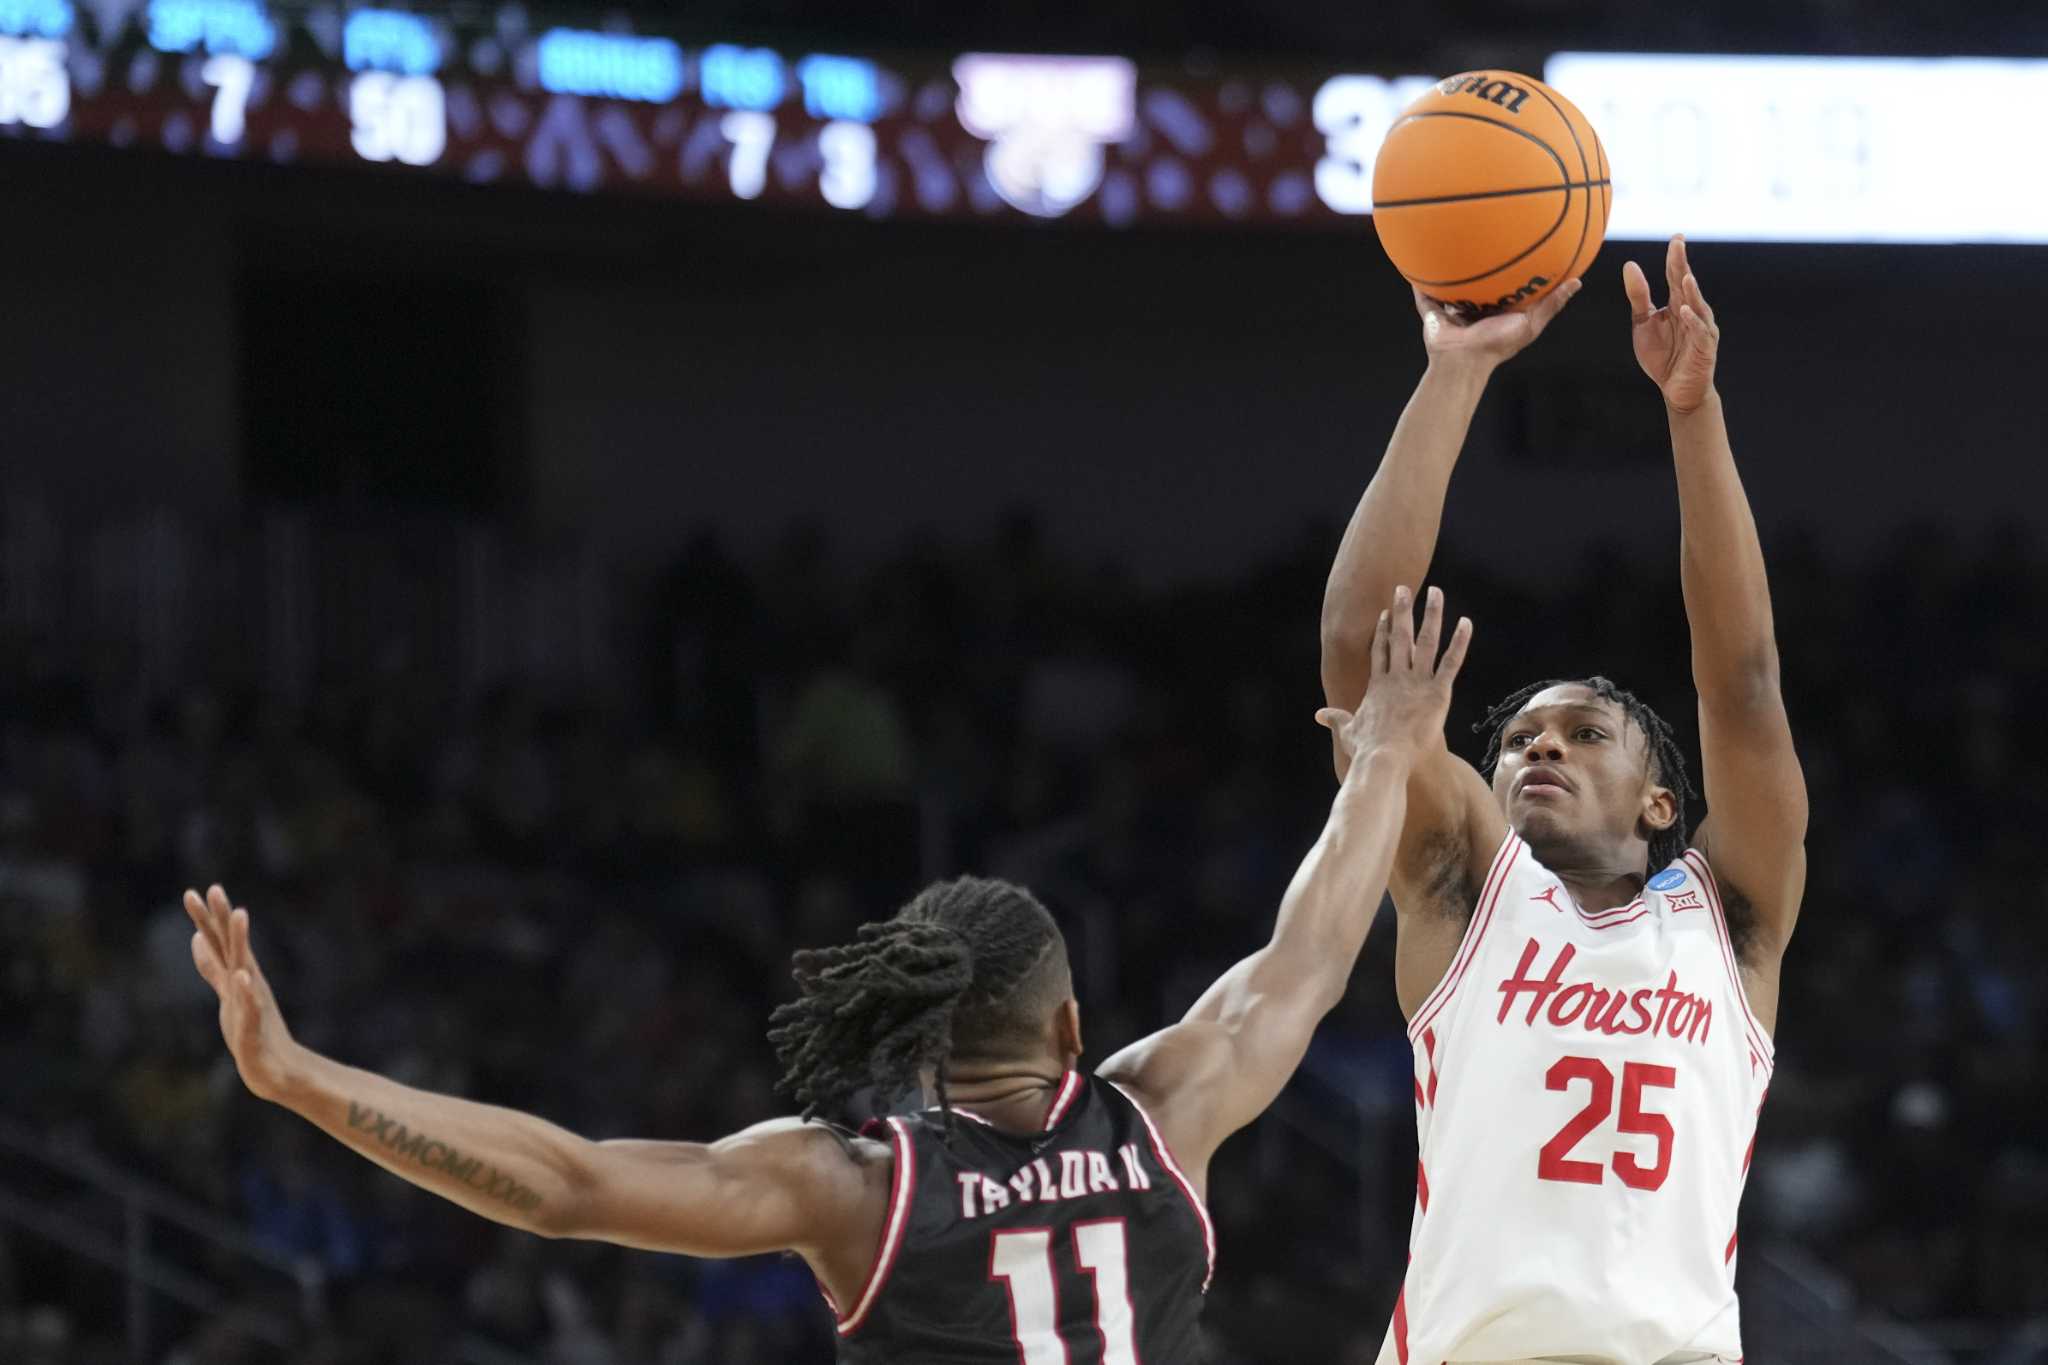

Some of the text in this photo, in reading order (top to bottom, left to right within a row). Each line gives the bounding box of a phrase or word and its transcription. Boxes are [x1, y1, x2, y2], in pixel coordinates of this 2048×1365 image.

[202, 53, 255, 143] 7
[720, 110, 776, 199] 7
[1497, 937, 1712, 1047] Houston
[1538, 1055, 1676, 1192] 25
[957, 1150, 1119, 1218] TAYLOR
[987, 1215, 1141, 1365] 11
